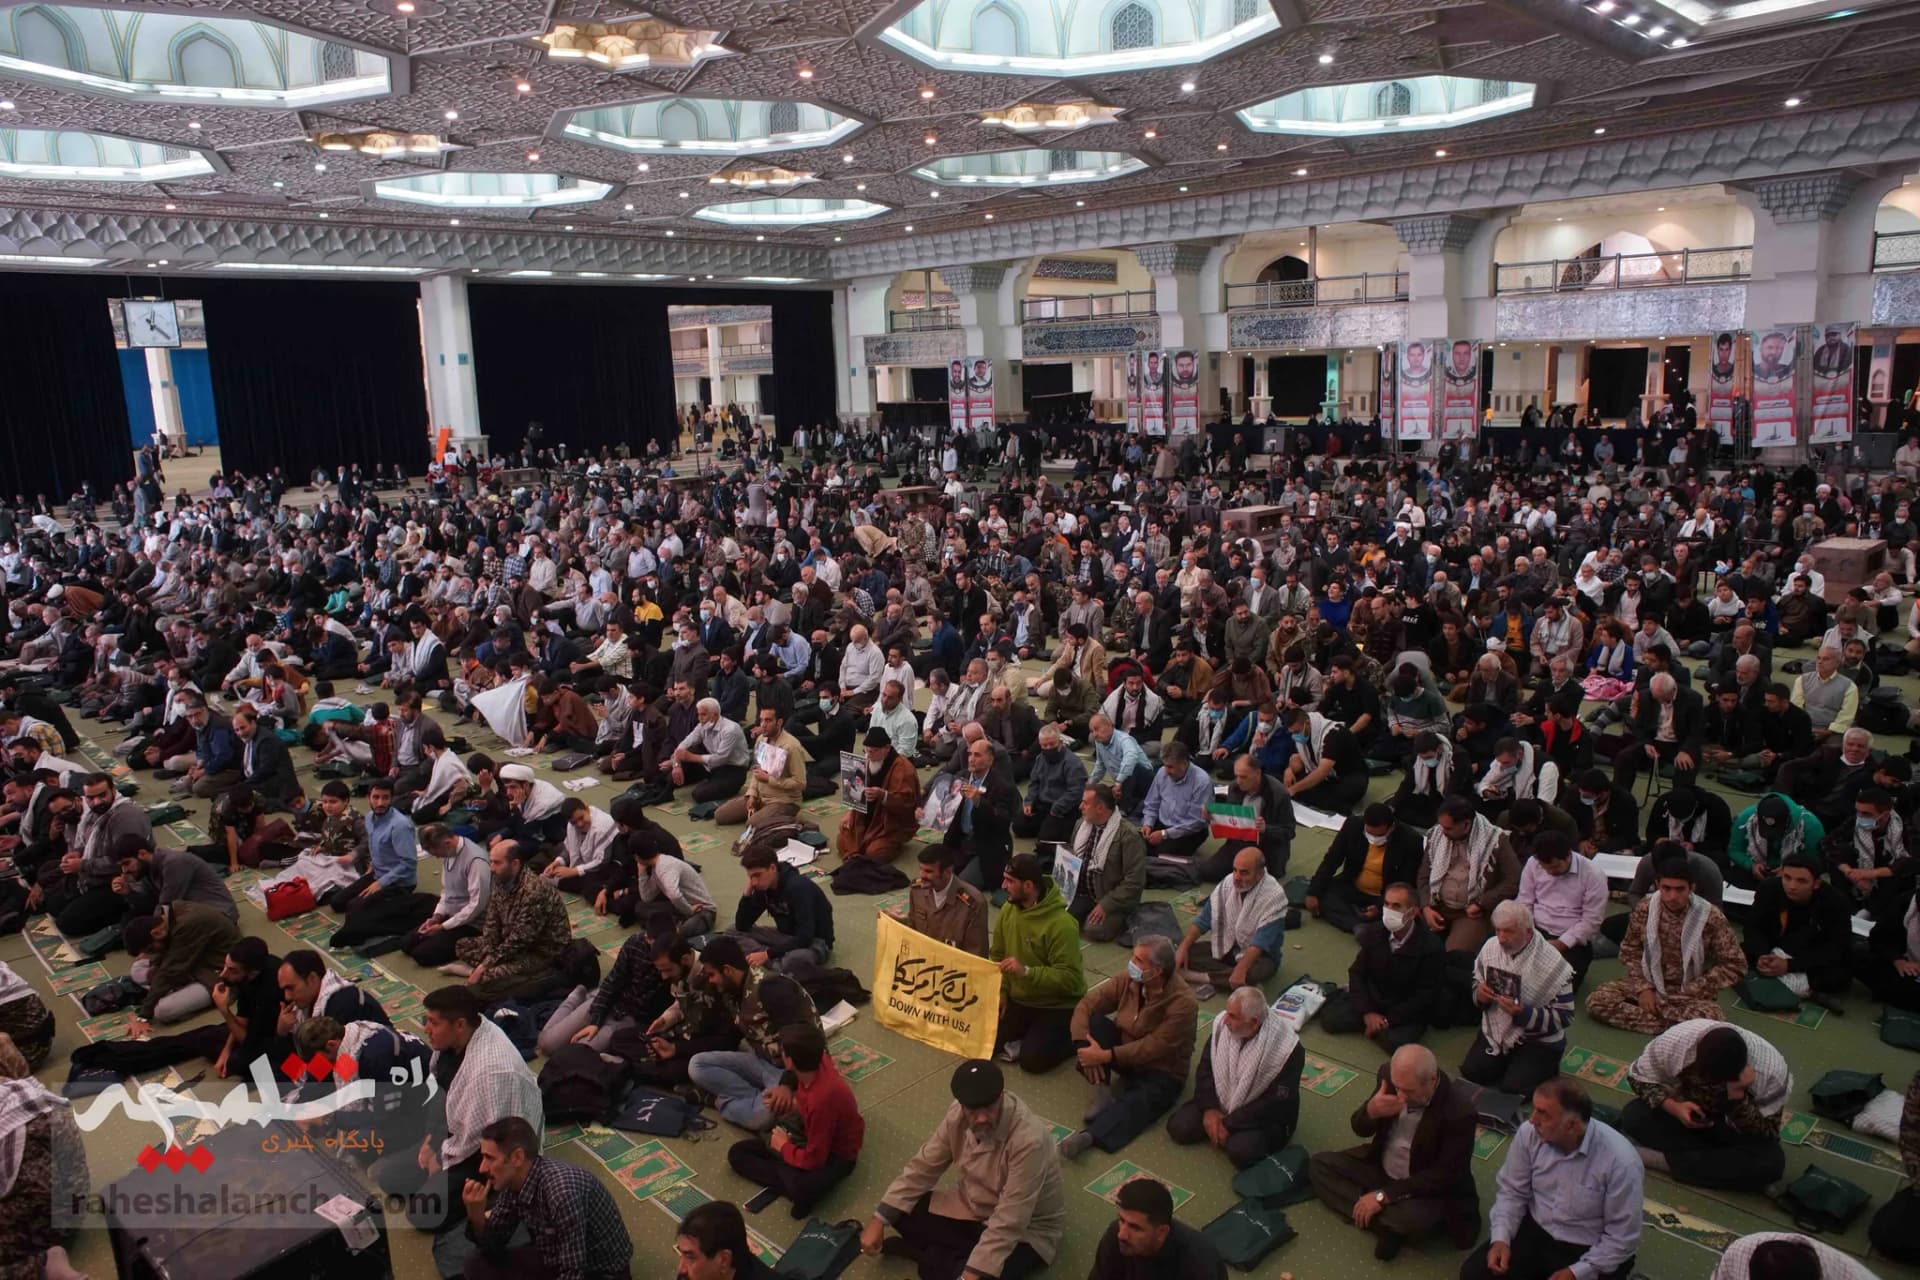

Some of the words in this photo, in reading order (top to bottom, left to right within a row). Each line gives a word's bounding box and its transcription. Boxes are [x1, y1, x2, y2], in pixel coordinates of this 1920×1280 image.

[939, 970, 978, 1012] مرگ
[889, 997, 921, 1017] DOWN
[923, 1010, 949, 1025] WITH
[952, 1019, 971, 1033] USA
